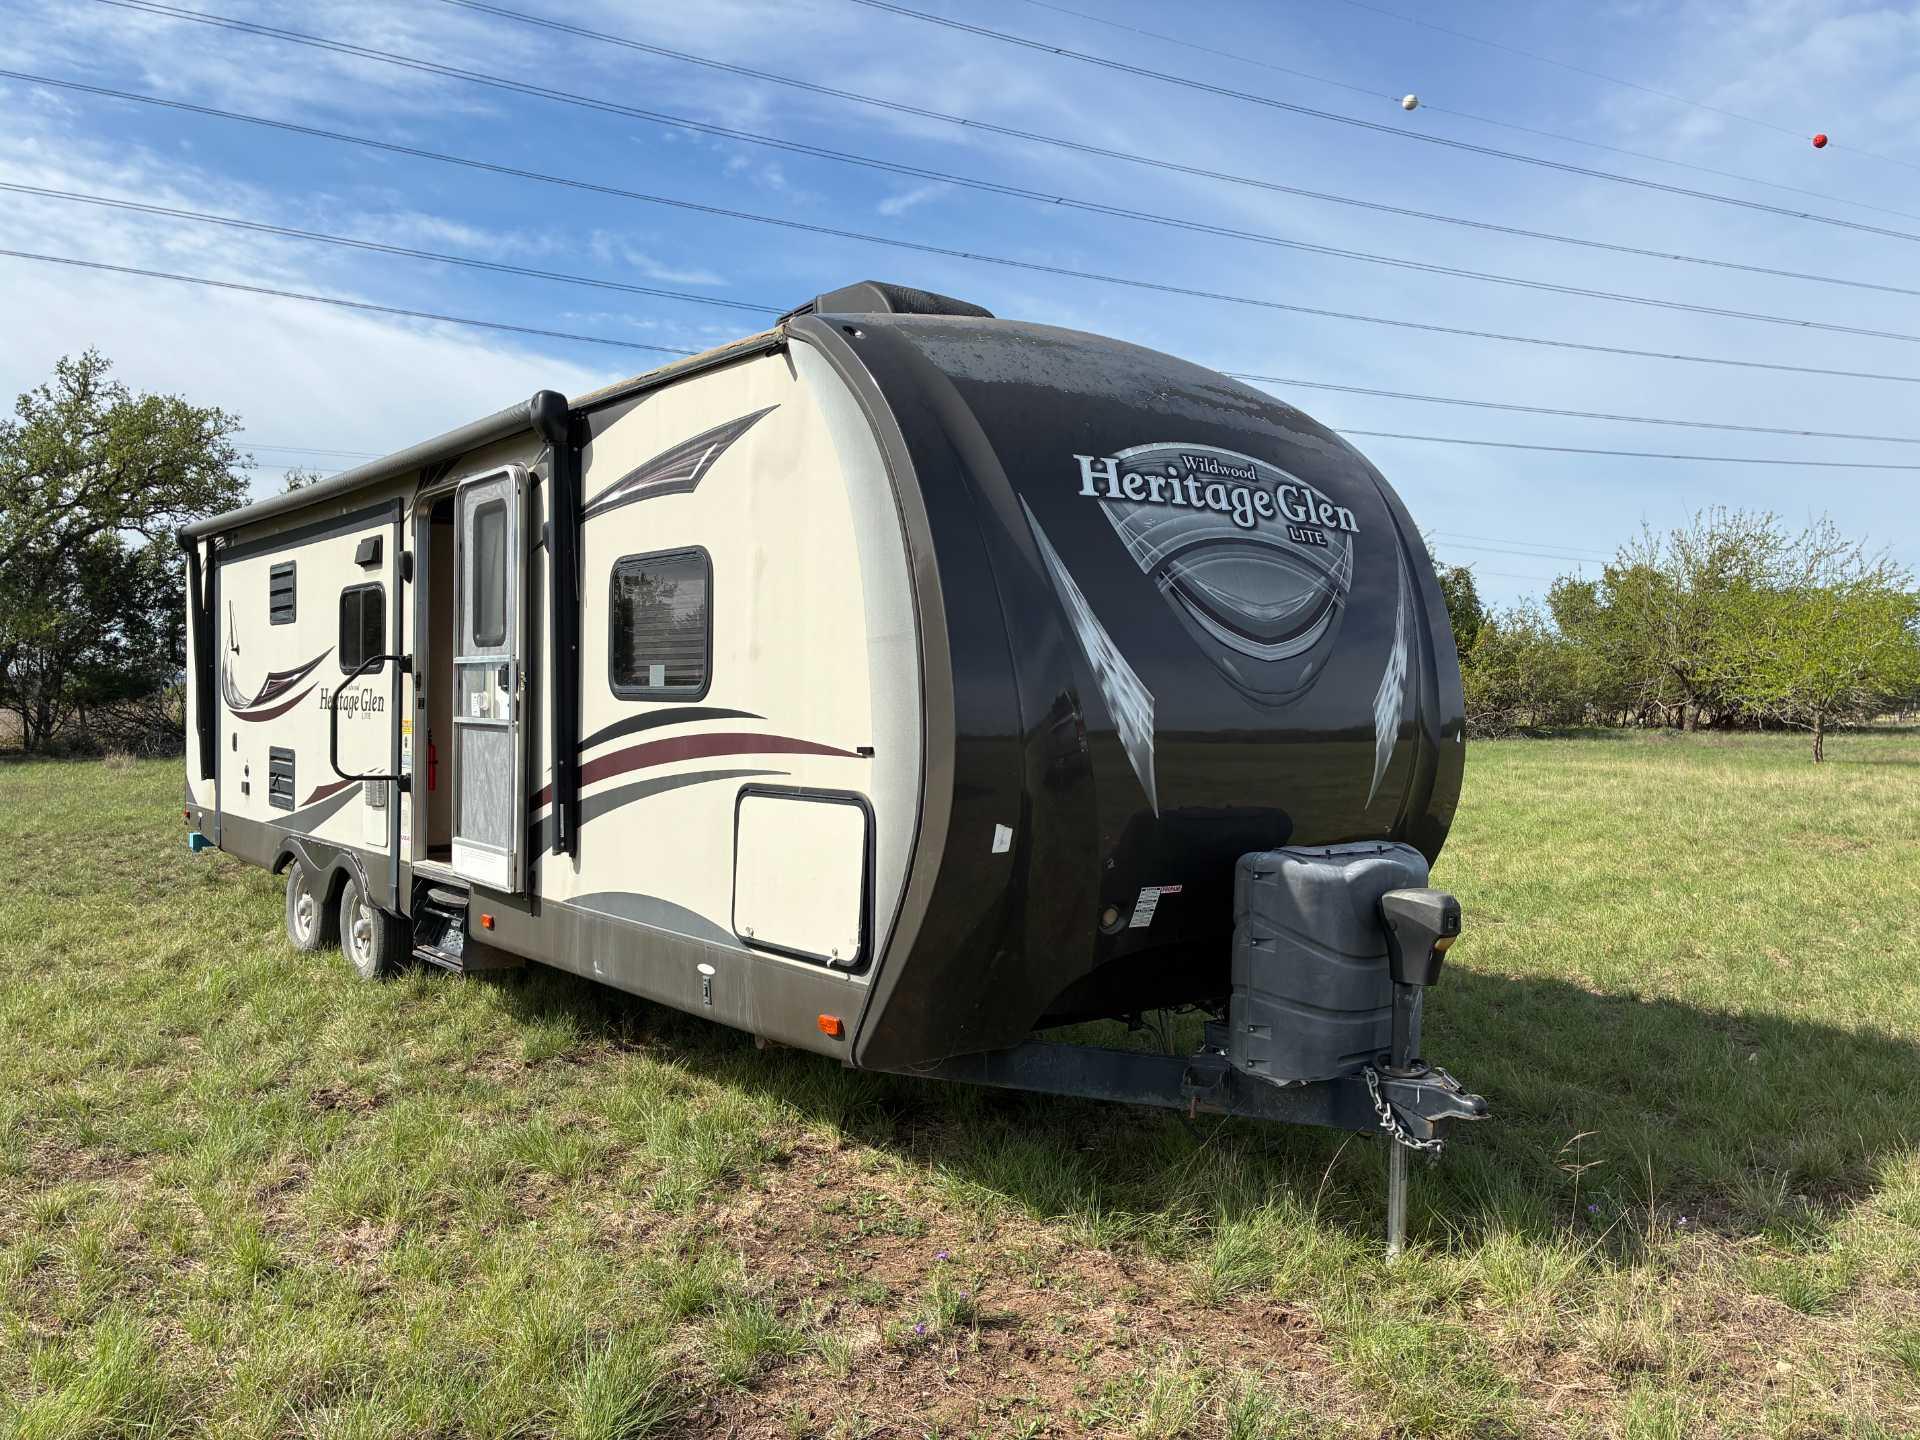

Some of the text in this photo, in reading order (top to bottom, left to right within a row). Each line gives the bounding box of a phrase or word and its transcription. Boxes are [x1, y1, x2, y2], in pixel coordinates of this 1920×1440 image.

[1181, 455, 1257, 480] Wildwood
[1073, 454, 1360, 533] Heritage Glen
[1289, 527, 1327, 545] LITE
[320, 688, 384, 719] Hetage Glen
